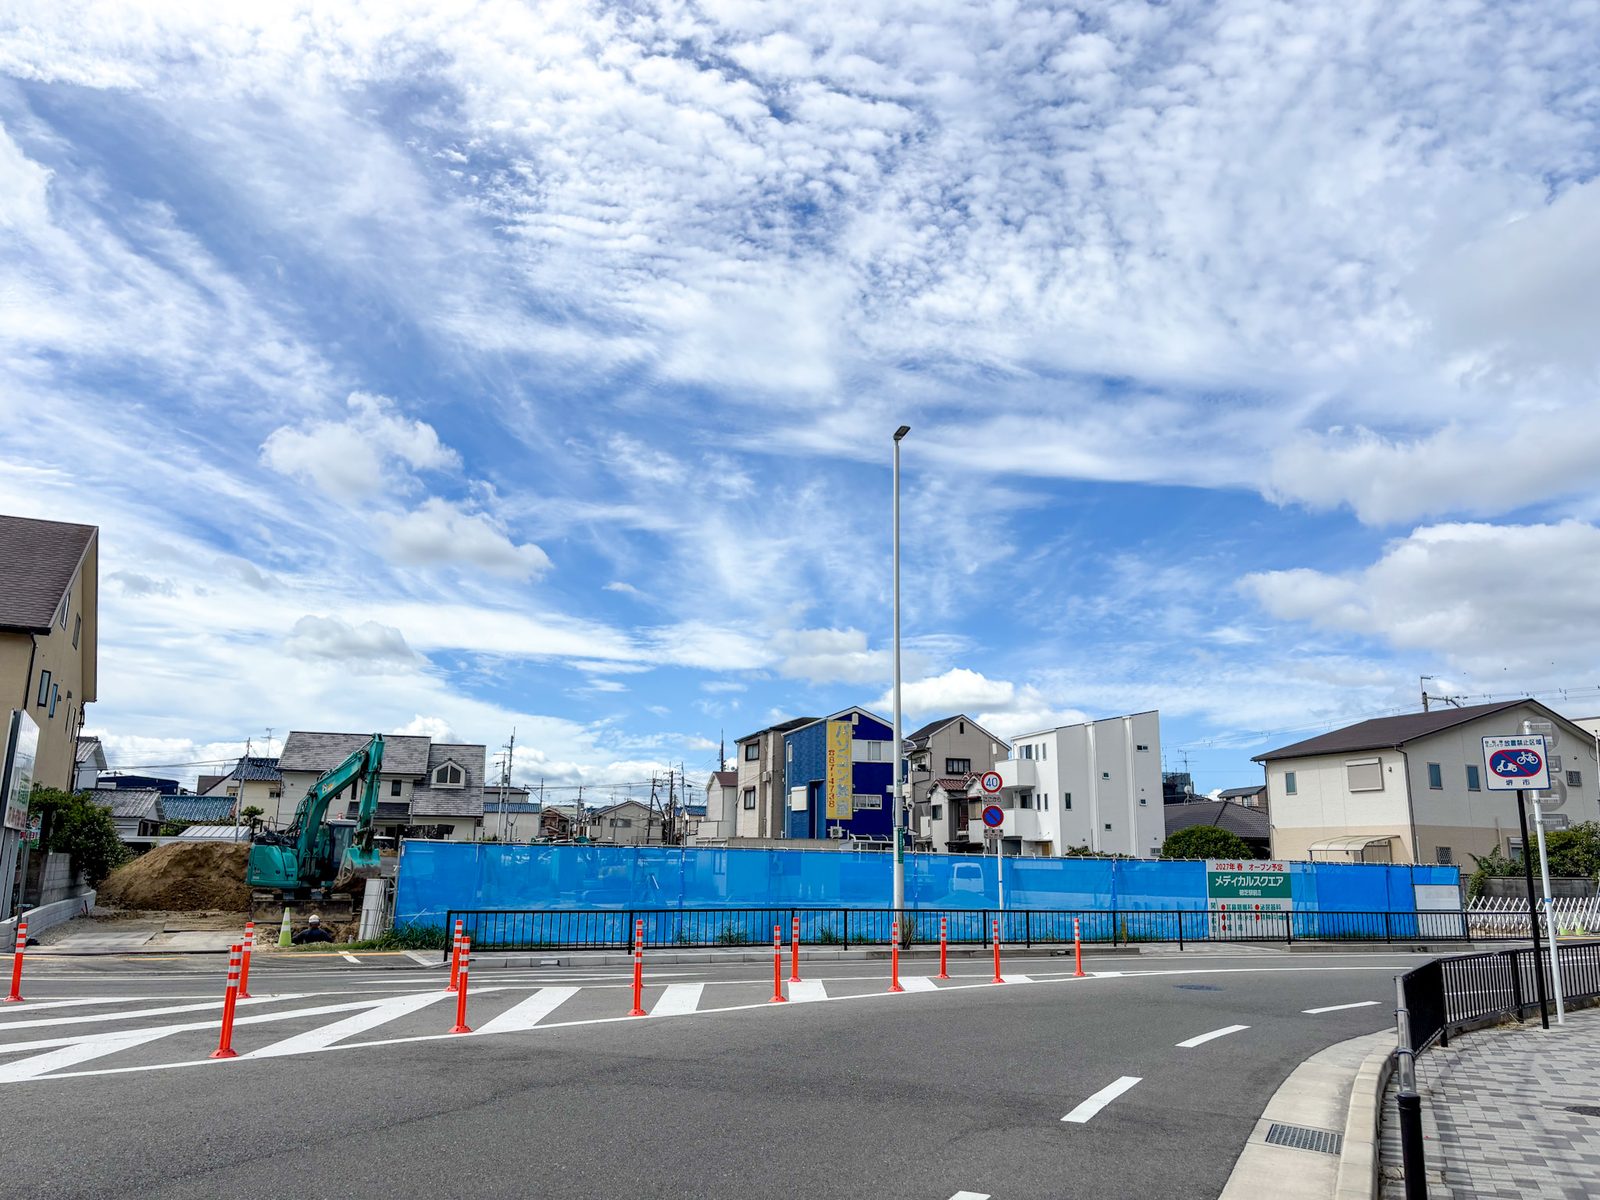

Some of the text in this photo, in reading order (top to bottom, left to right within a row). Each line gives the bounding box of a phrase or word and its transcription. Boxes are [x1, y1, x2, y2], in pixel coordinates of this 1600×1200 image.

[1504, 738, 1542, 746] 放置禁止区域
[986, 777, 998, 787] 40
[1215, 863, 1283, 871] 2027年 春 オープン予定
[1215, 875, 1284, 887] メディカルスクエア
